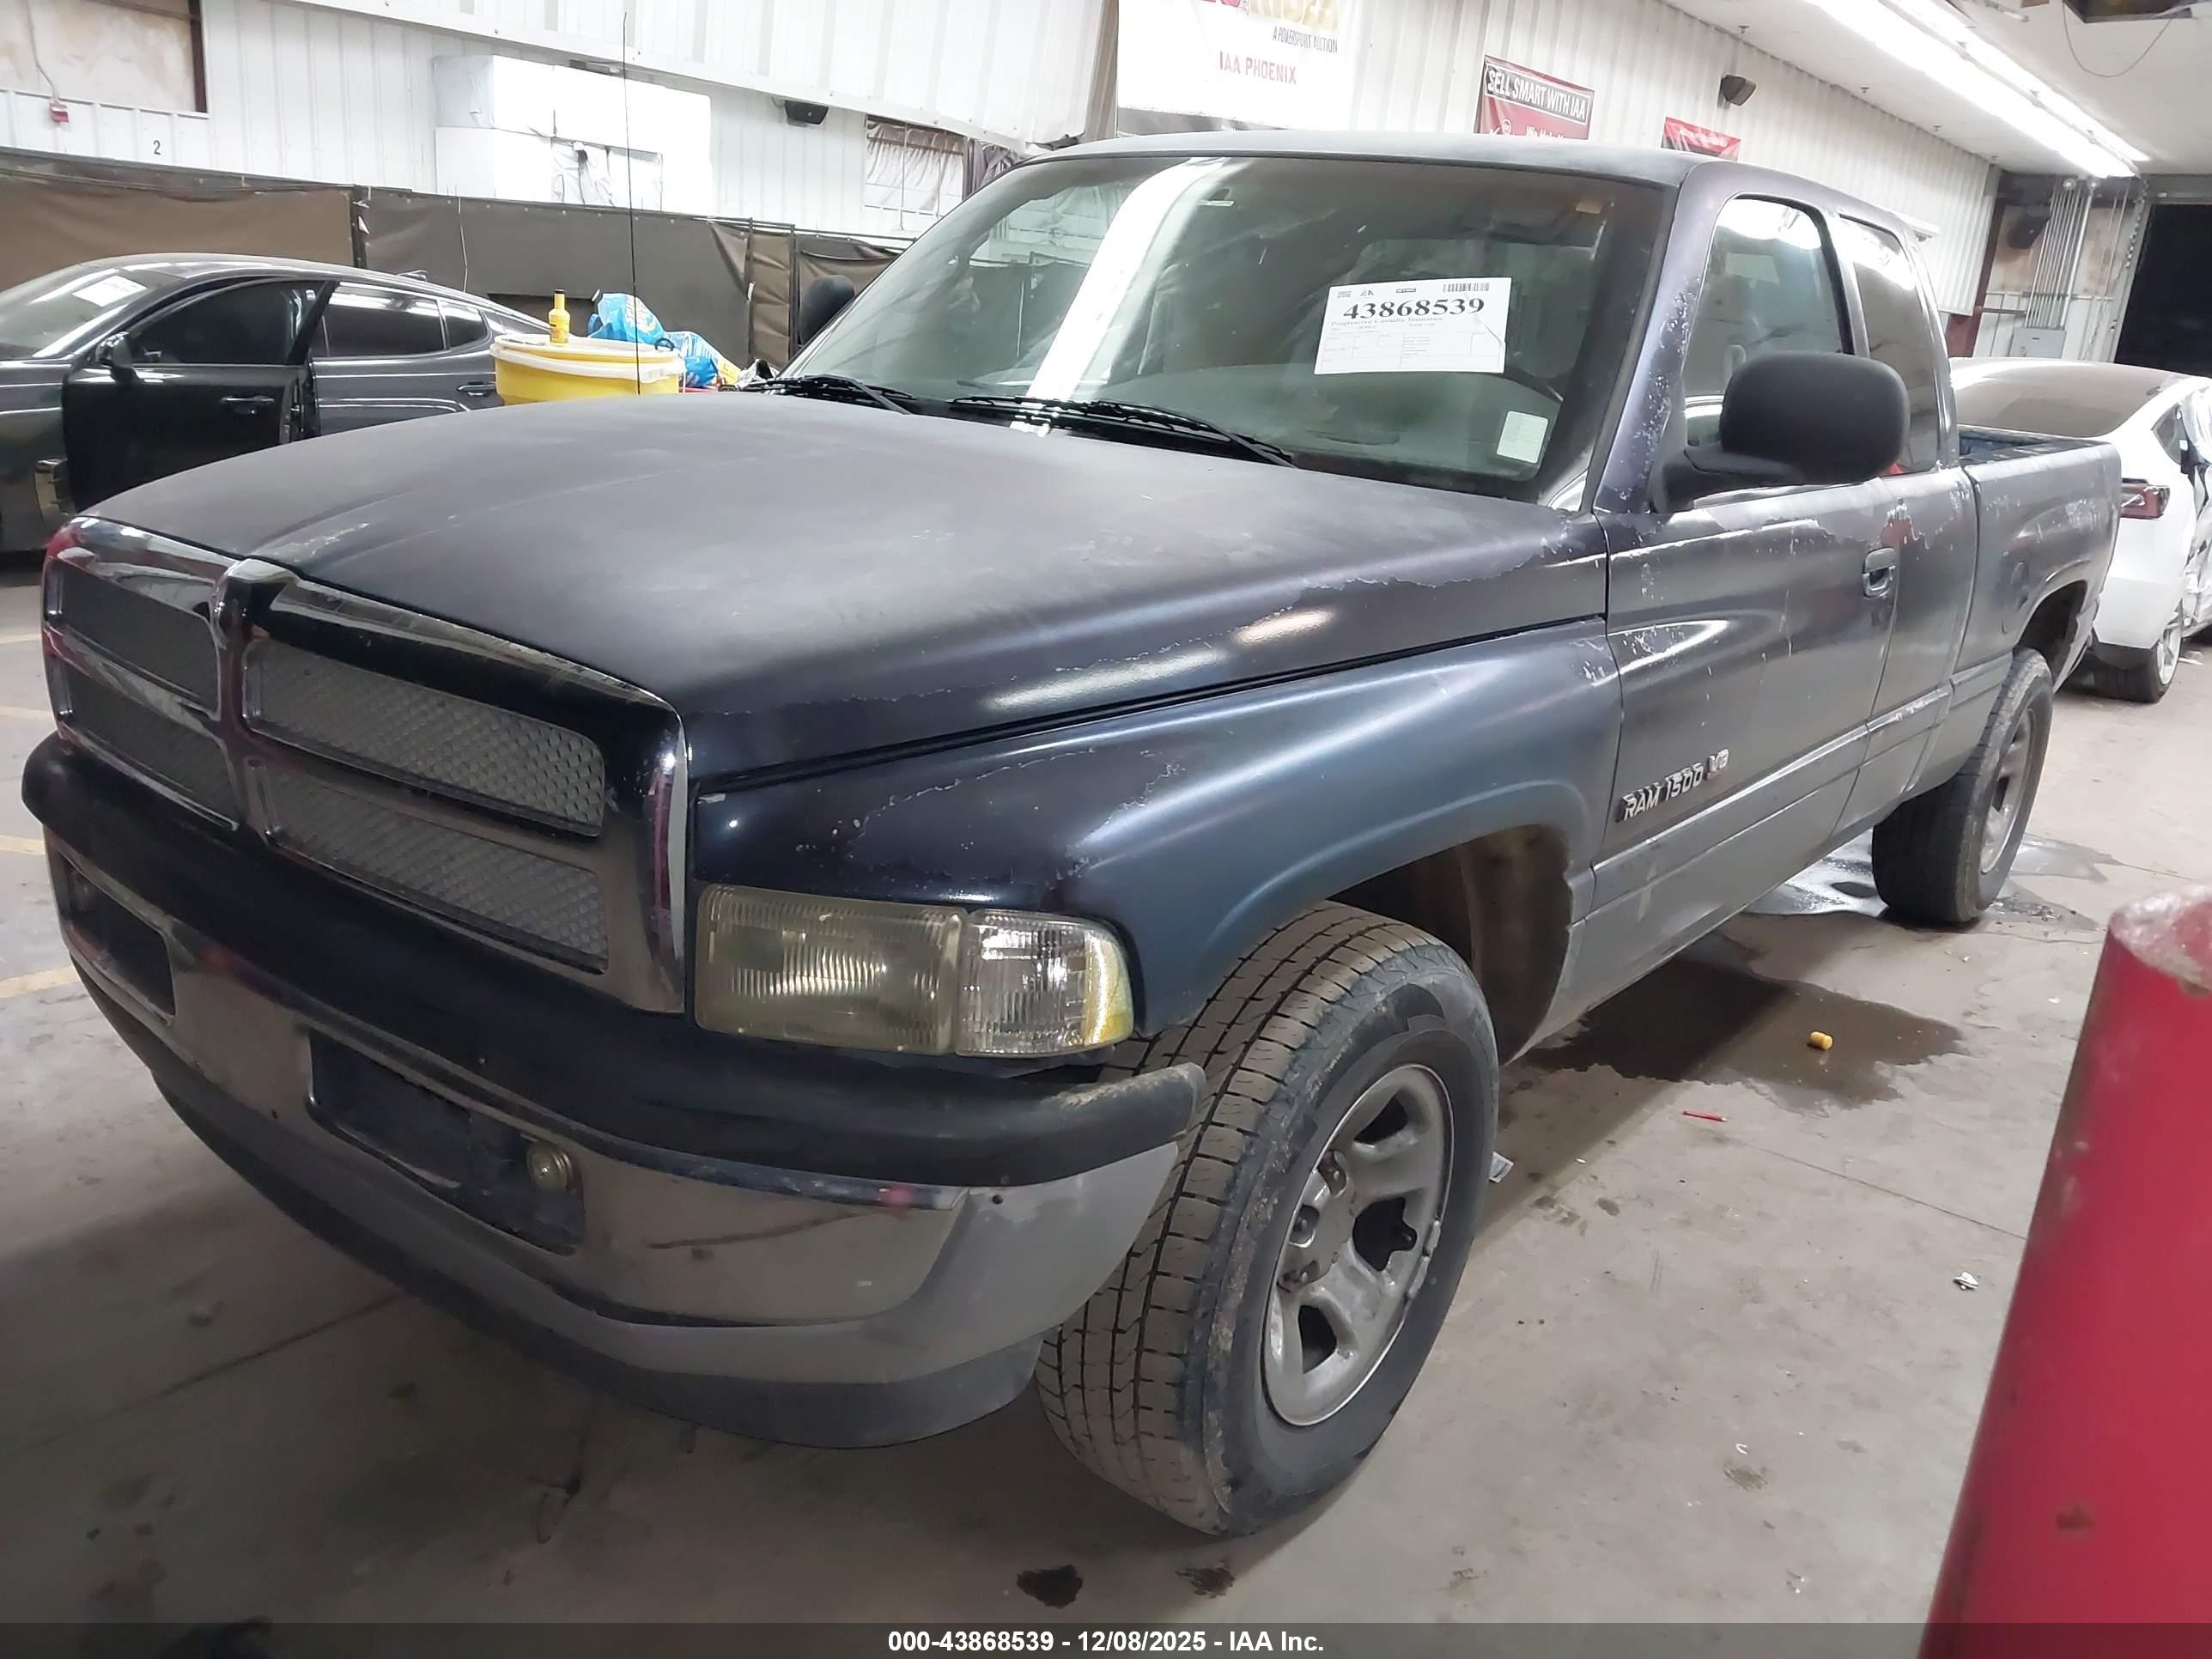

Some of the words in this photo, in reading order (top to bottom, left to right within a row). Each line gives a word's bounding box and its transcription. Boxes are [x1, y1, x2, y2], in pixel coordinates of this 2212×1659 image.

[1272, 26, 1279, 41] A
[1278, 27, 1312, 49] POWERSPORT
[1313, 36, 1338, 53] AUCTION
[1219, 51, 1241, 74] IAA
[1245, 57, 1297, 84] PHOENIX
[1487, 70, 1510, 96] SELL
[1512, 77, 1547, 106] SMART
[1547, 88, 1571, 114] WITH
[1570, 94, 1586, 120] IAA
[153, 139, 161, 155] 2
[1343, 298, 1485, 319] 43868539
[1622, 781, 1664, 821] RAM
[1664, 762, 1705, 801] 1500
[1708, 749, 1729, 772] V8
